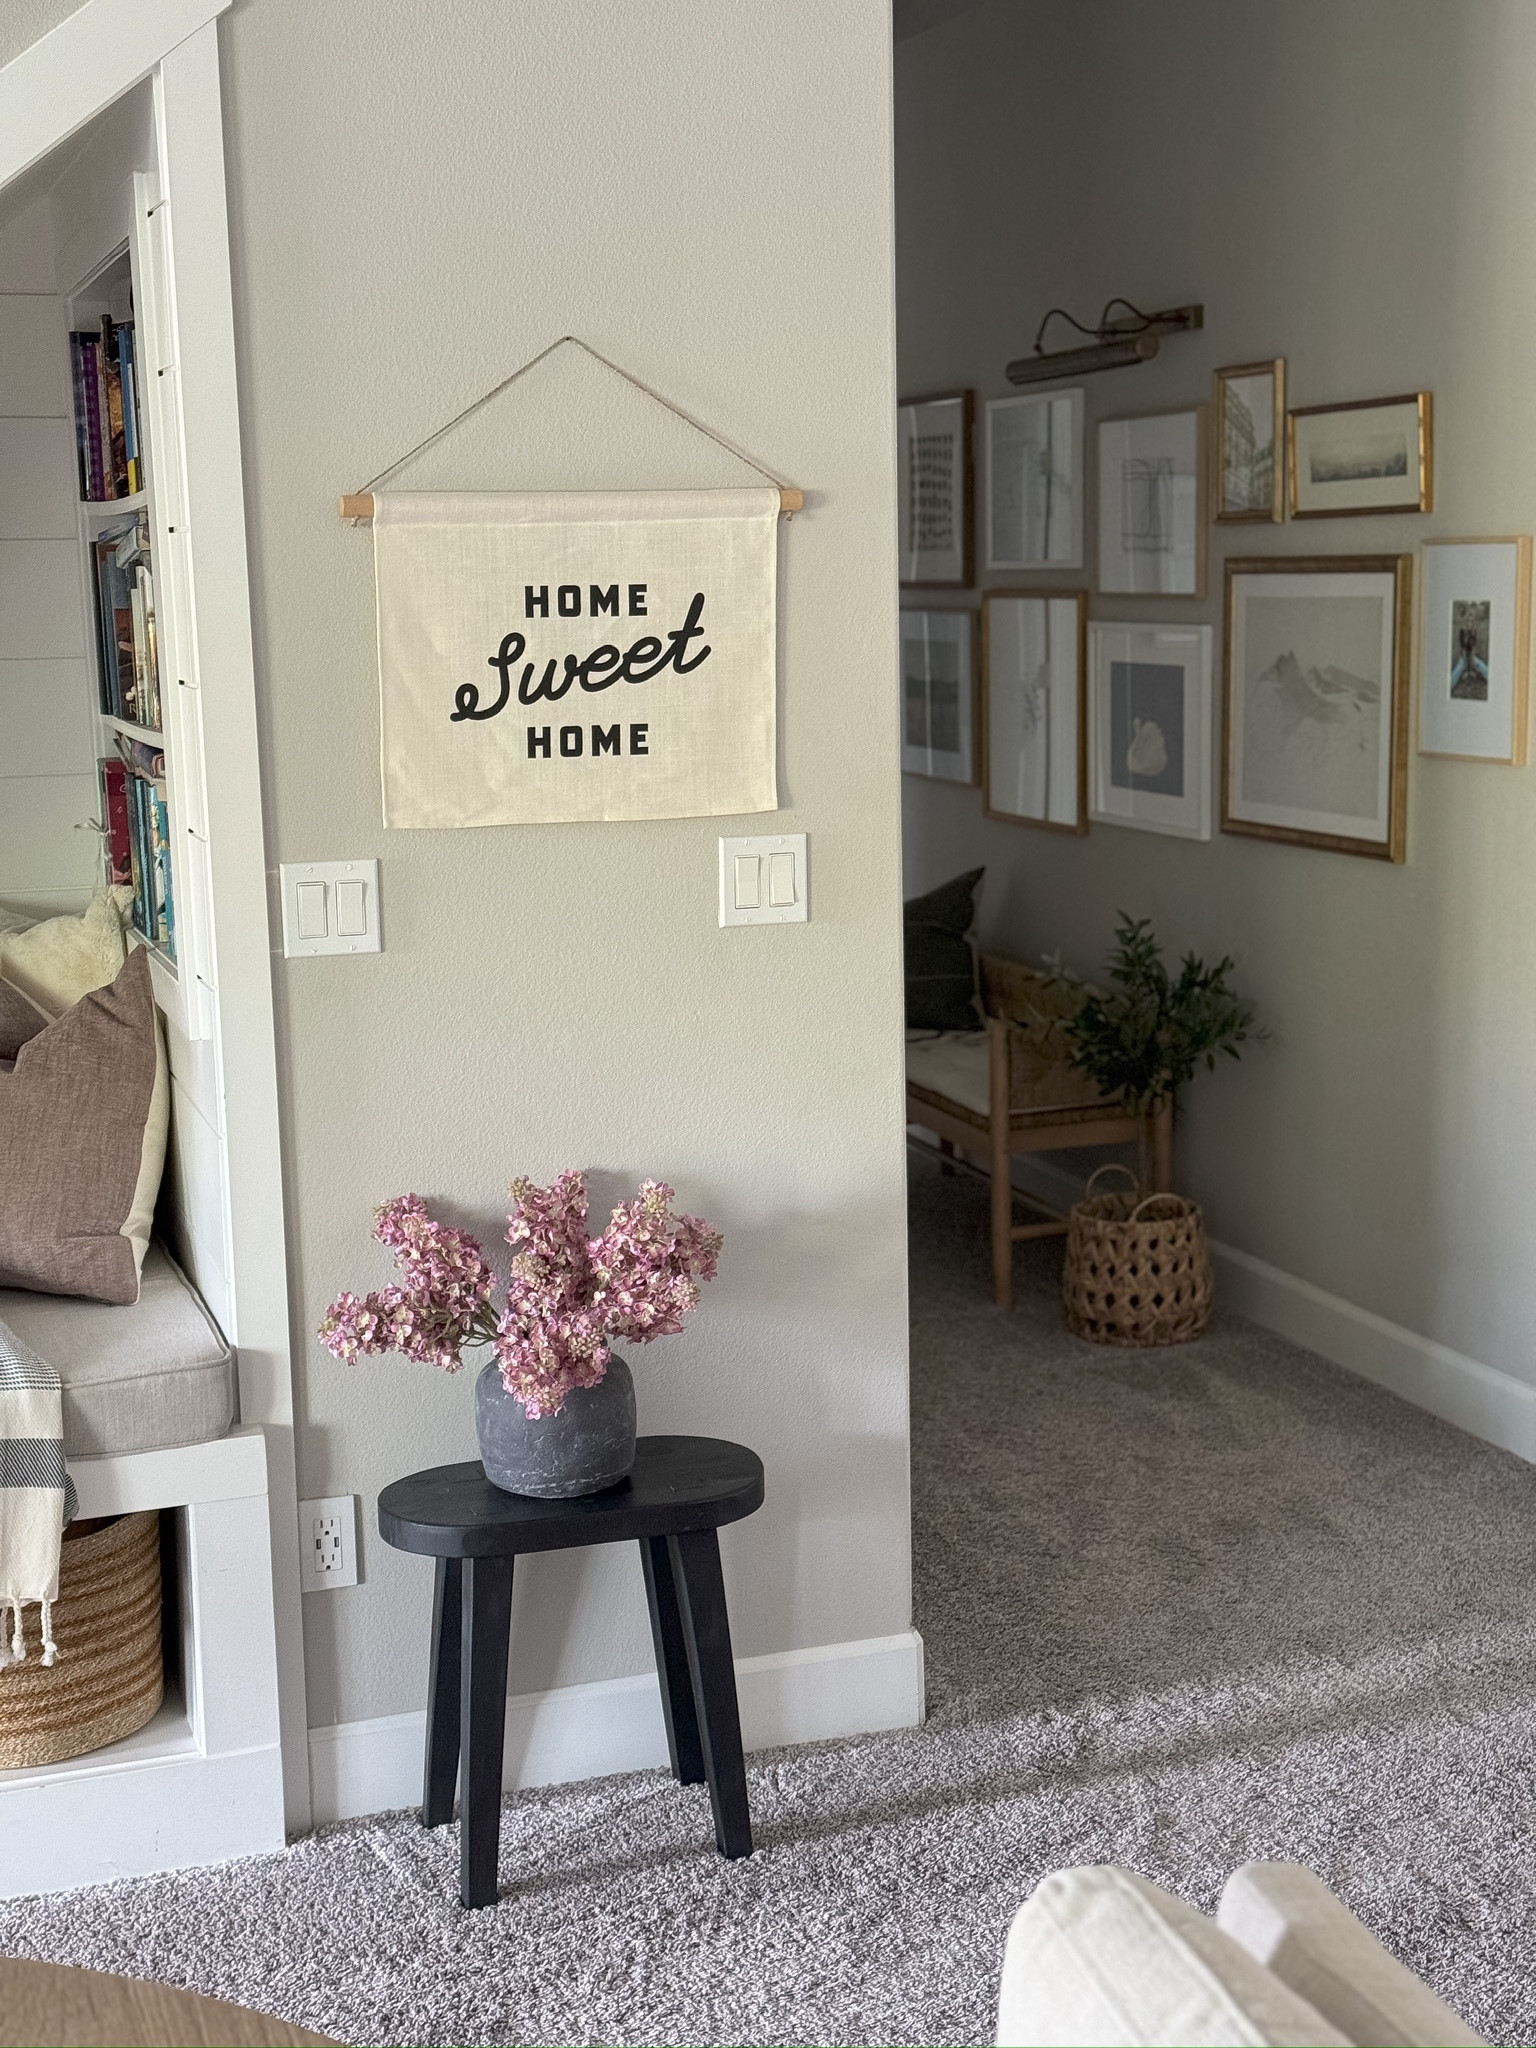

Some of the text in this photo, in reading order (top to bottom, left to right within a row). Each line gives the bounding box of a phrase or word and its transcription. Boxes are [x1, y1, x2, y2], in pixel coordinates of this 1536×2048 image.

[524, 583, 648, 618] HOME
[450, 592, 711, 722] Sweet
[527, 723, 649, 758] HOME
